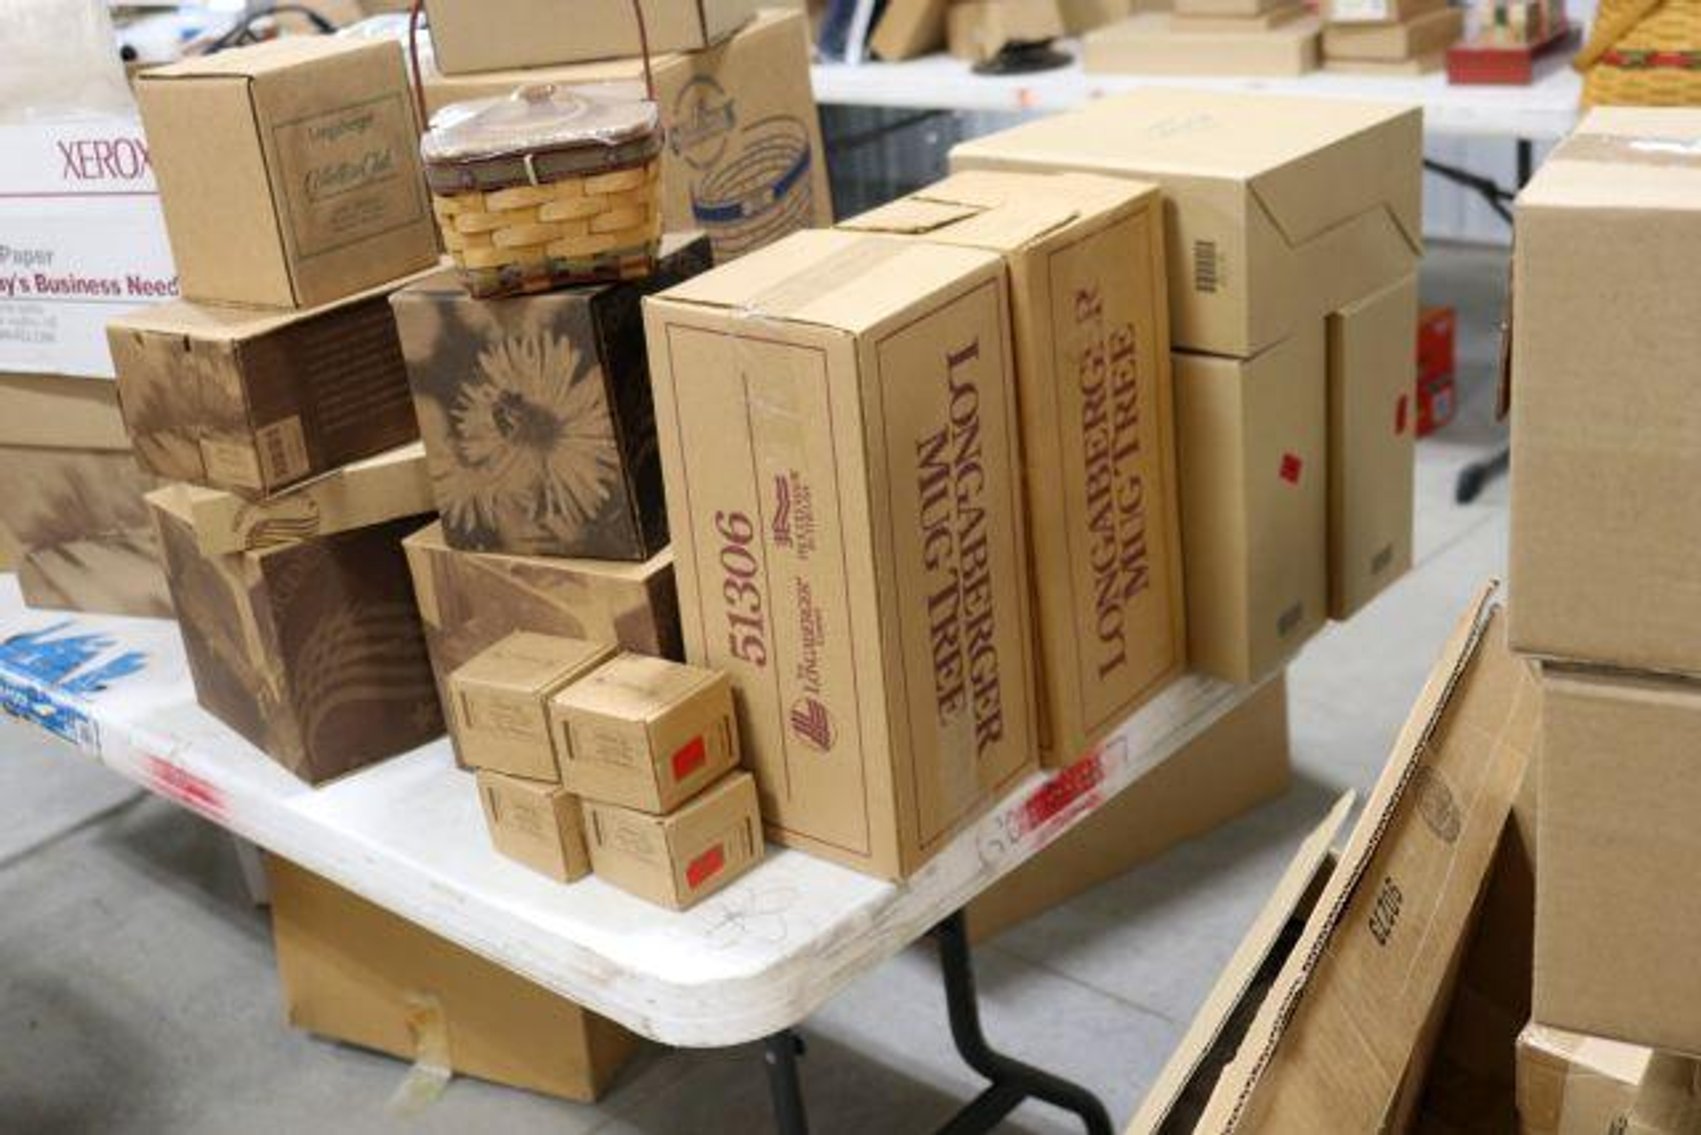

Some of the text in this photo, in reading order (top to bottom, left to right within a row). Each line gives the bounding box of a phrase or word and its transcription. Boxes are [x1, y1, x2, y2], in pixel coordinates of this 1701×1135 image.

[0, 245, 53, 270] Paper
[57, 138, 152, 180] XEROX
[34, 273, 121, 296] Business
[946, 337, 1004, 754] LONGABERGER
[1076, 287, 1127, 681] LONGABERGR
[1109, 322, 1149, 600] MUG TREE
[715, 510, 767, 668] 51306
[915, 425, 967, 727] MUG TREE
